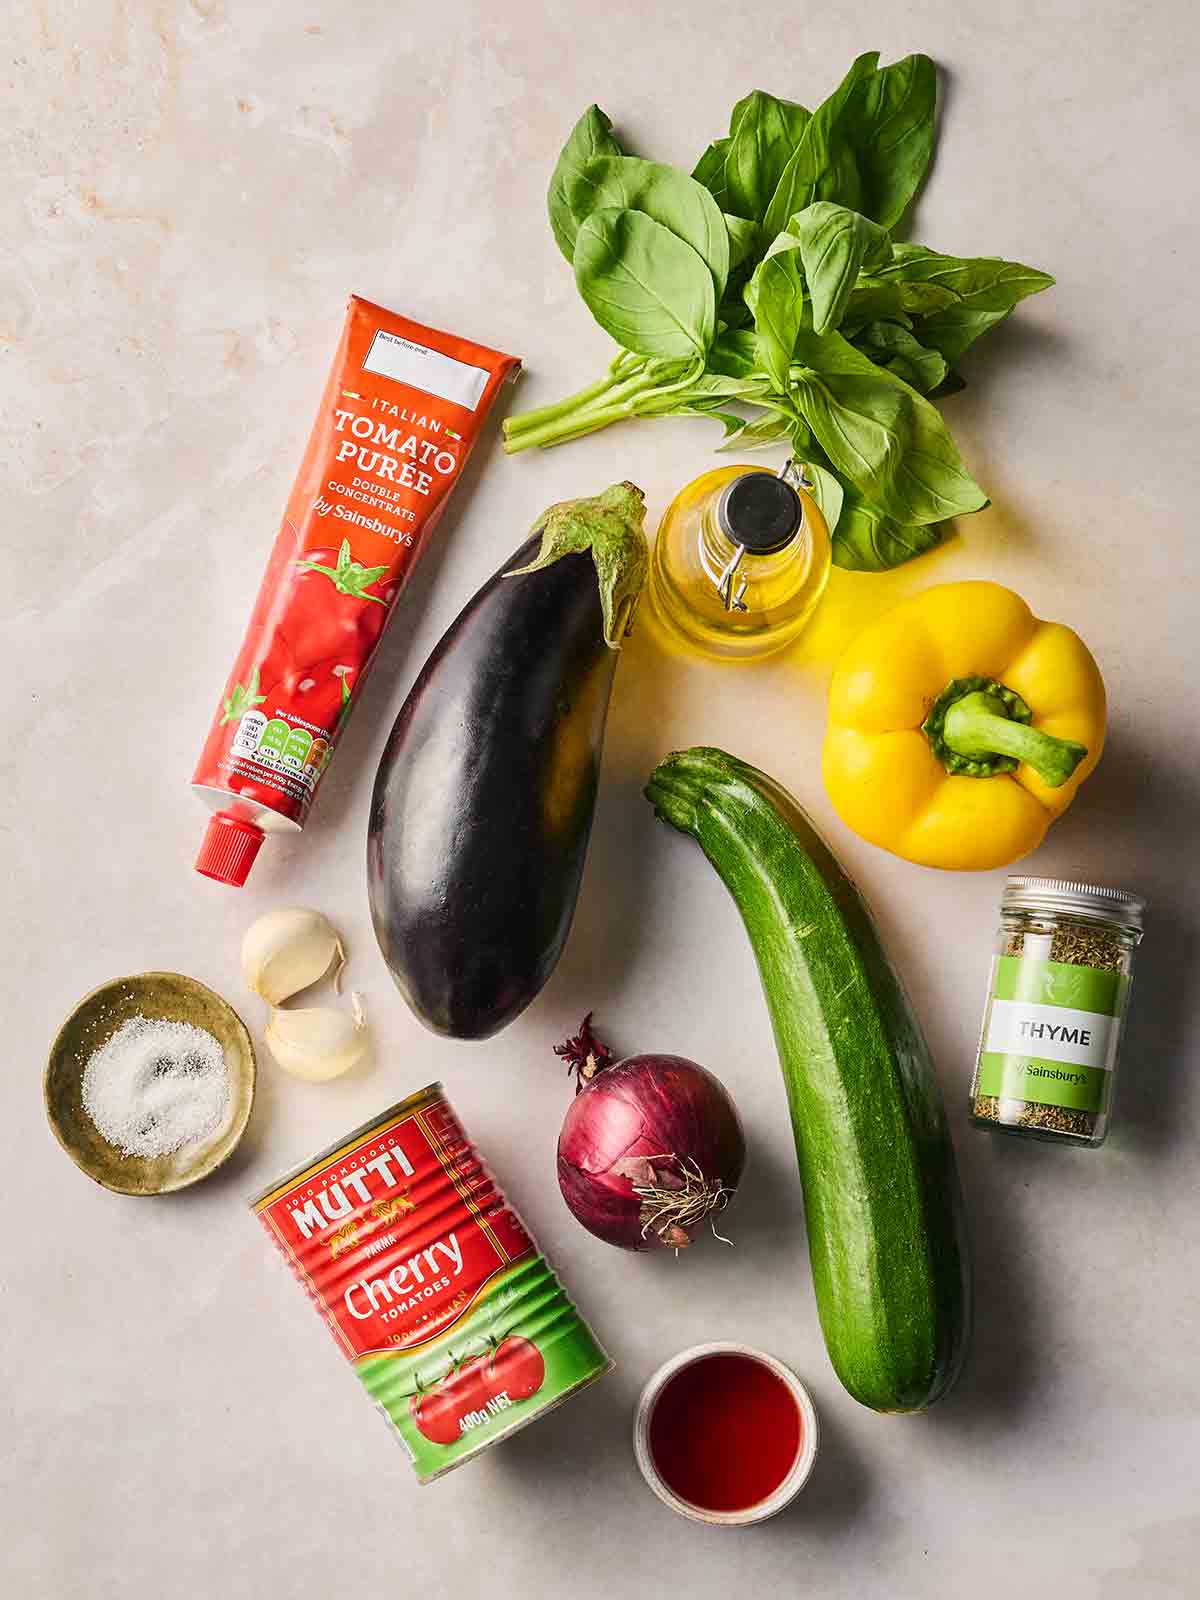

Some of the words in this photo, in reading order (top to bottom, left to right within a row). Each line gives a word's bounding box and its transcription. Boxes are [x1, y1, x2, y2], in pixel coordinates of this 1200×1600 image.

[371, 398, 442, 433] ITALIAN
[335, 409, 456, 474] TOMATO
[335, 440, 433, 496] PURÉE
[351, 477, 400, 502] DOUBLE
[312, 495, 334, 517] by
[333, 504, 415, 548] Sainsbury's
[327, 480, 416, 521] CONCENTRATE
[1019, 1021, 1092, 1046] THYME
[1025, 1064, 1089, 1086] Sainsbury's
[285, 1190, 314, 1210] SOLO
[322, 1138, 396, 1188] POMODORO
[290, 1145, 416, 1240] MUTTI
[364, 1233, 397, 1258] PARMA
[344, 1233, 464, 1320] Cherry
[381, 1276, 450, 1323] TOMATOES
[458, 1408, 491, 1433] 400g
[486, 1391, 513, 1416] NET
